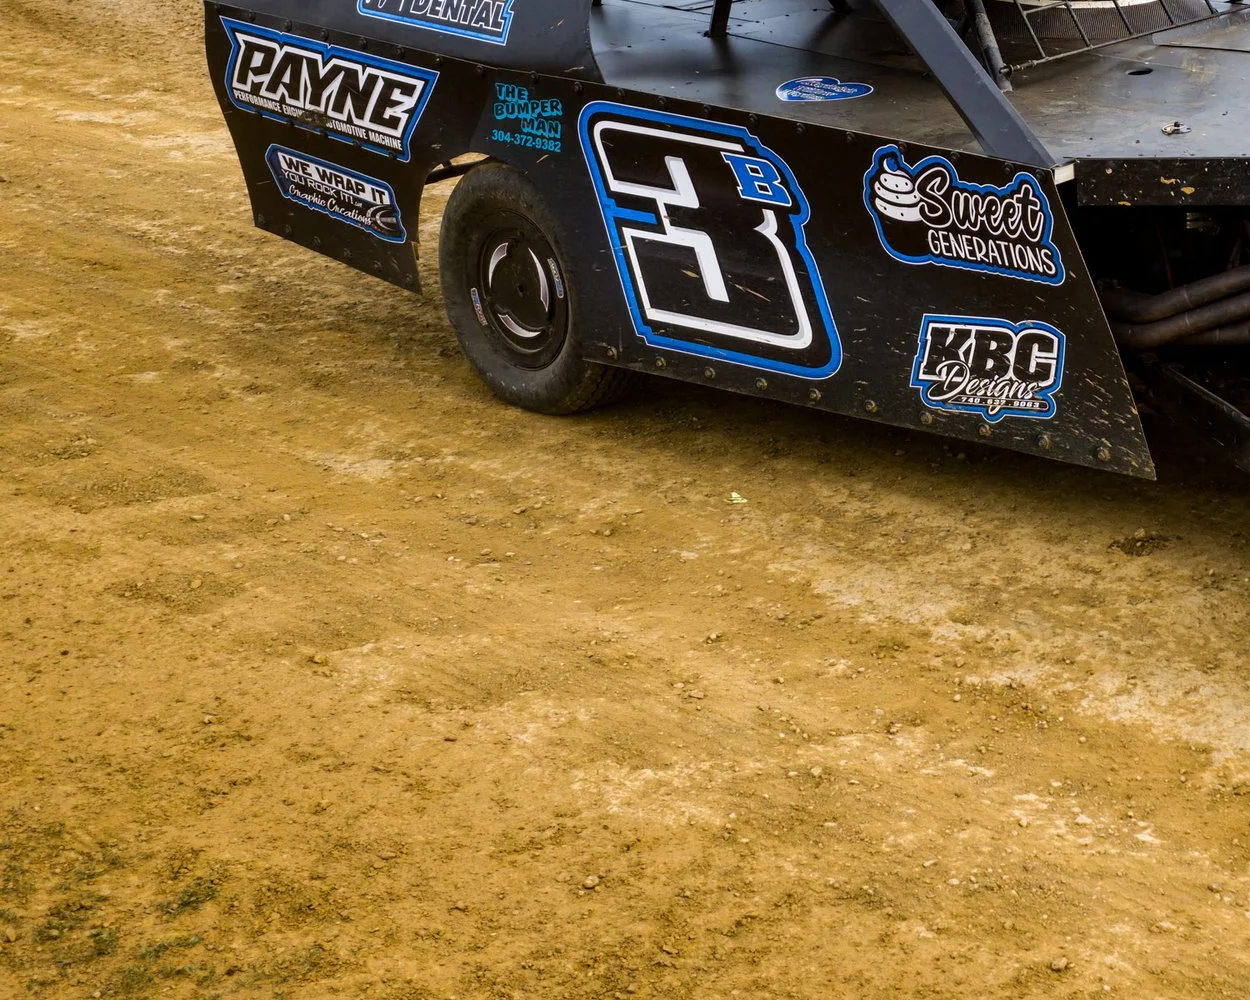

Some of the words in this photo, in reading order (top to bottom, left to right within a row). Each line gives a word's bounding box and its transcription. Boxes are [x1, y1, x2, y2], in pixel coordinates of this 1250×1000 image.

[232, 32, 425, 138] PAYNE
[494, 82, 528, 101] THE
[494, 98, 562, 120] BUMPER
[233, 89, 282, 113] PERFORMANCE
[368, 131, 403, 151] MACHINE
[491, 129, 562, 153] 304-372-9382
[521, 117, 561, 139] MAN
[281, 169, 305, 186] YOU
[307, 179, 337, 198] ROCK
[282, 155, 313, 177] WE
[315, 167, 366, 196] WRAP
[371, 187, 386, 205] IT
[288, 184, 326, 207] Graphic
[327, 198, 372, 226] Creations
[915, 167, 1043, 242] Sweet
[593, 120, 813, 350] 3
[720, 151, 792, 207] B
[928, 229, 1056, 275] GENERATIONS
[919, 323, 1059, 387] KBC
[928, 360, 1040, 415] Designs
